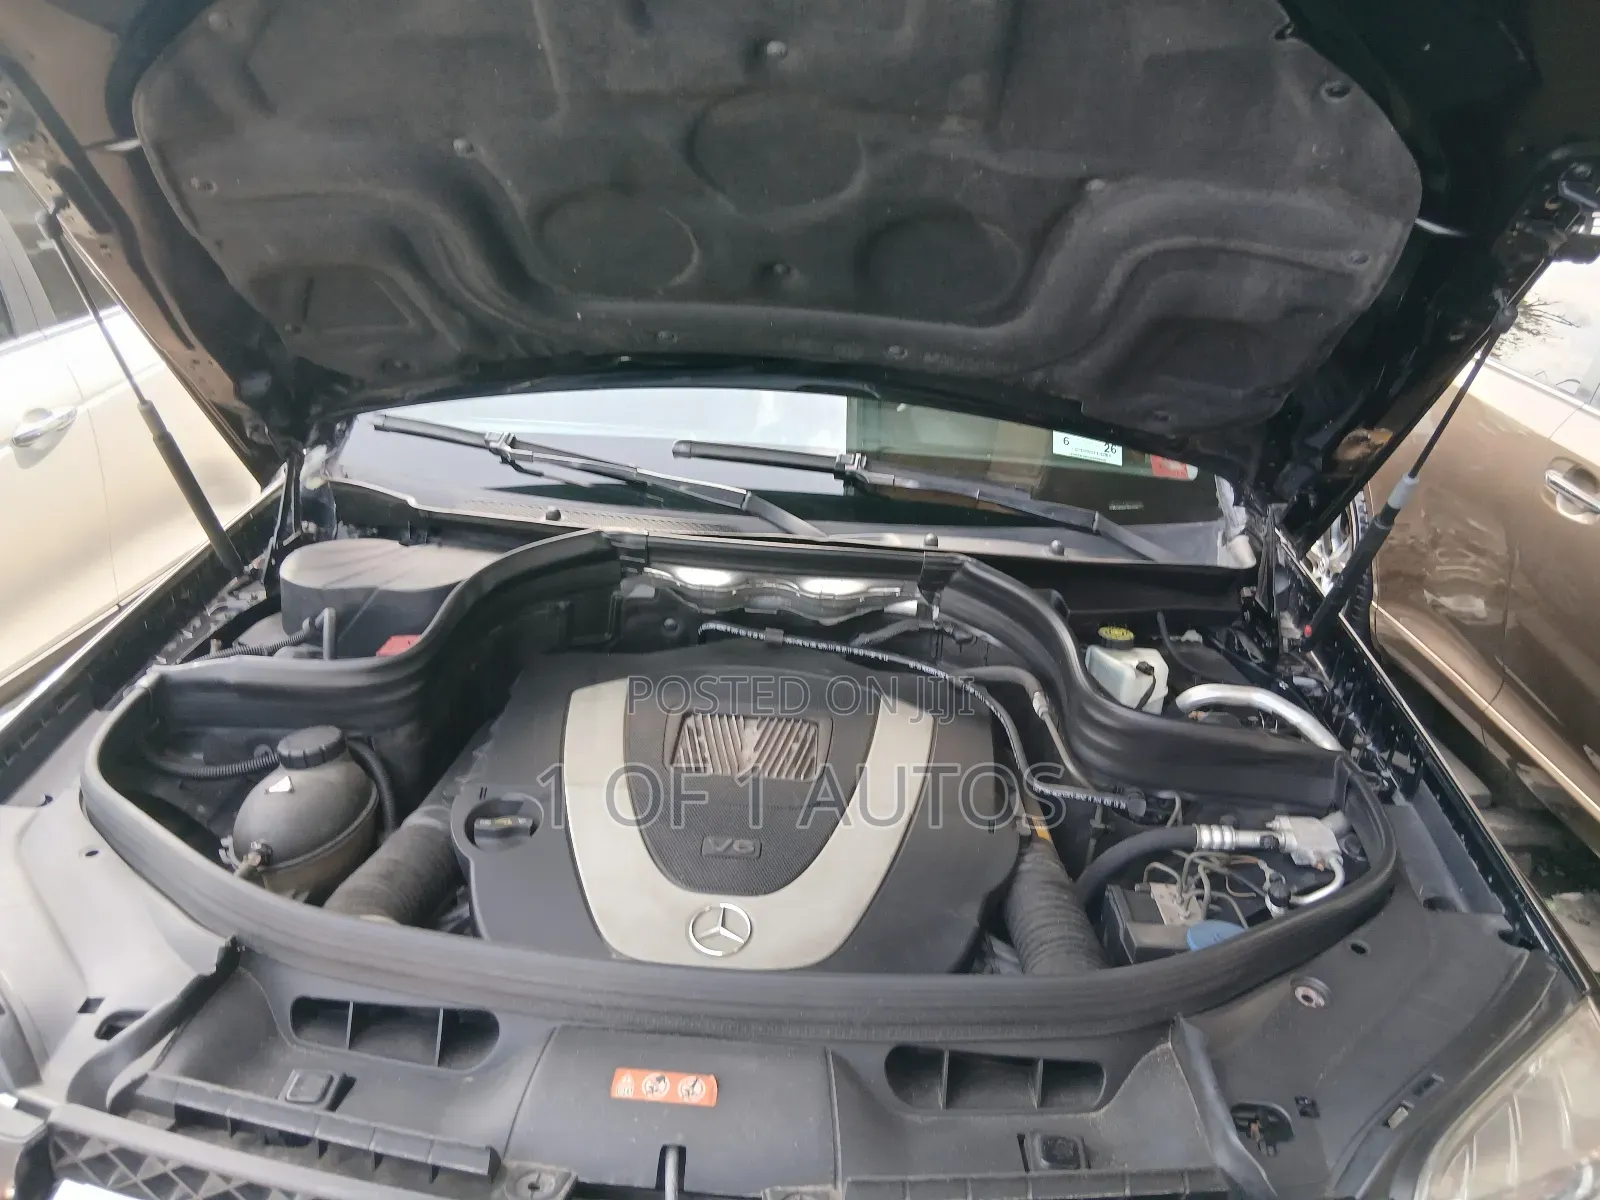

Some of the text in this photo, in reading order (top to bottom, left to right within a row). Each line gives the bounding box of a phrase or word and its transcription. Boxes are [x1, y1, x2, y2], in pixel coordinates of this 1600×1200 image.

[1063, 436, 1069, 446] 6
[1104, 442, 1117, 454] 26
[708, 838, 755, 854] V6
